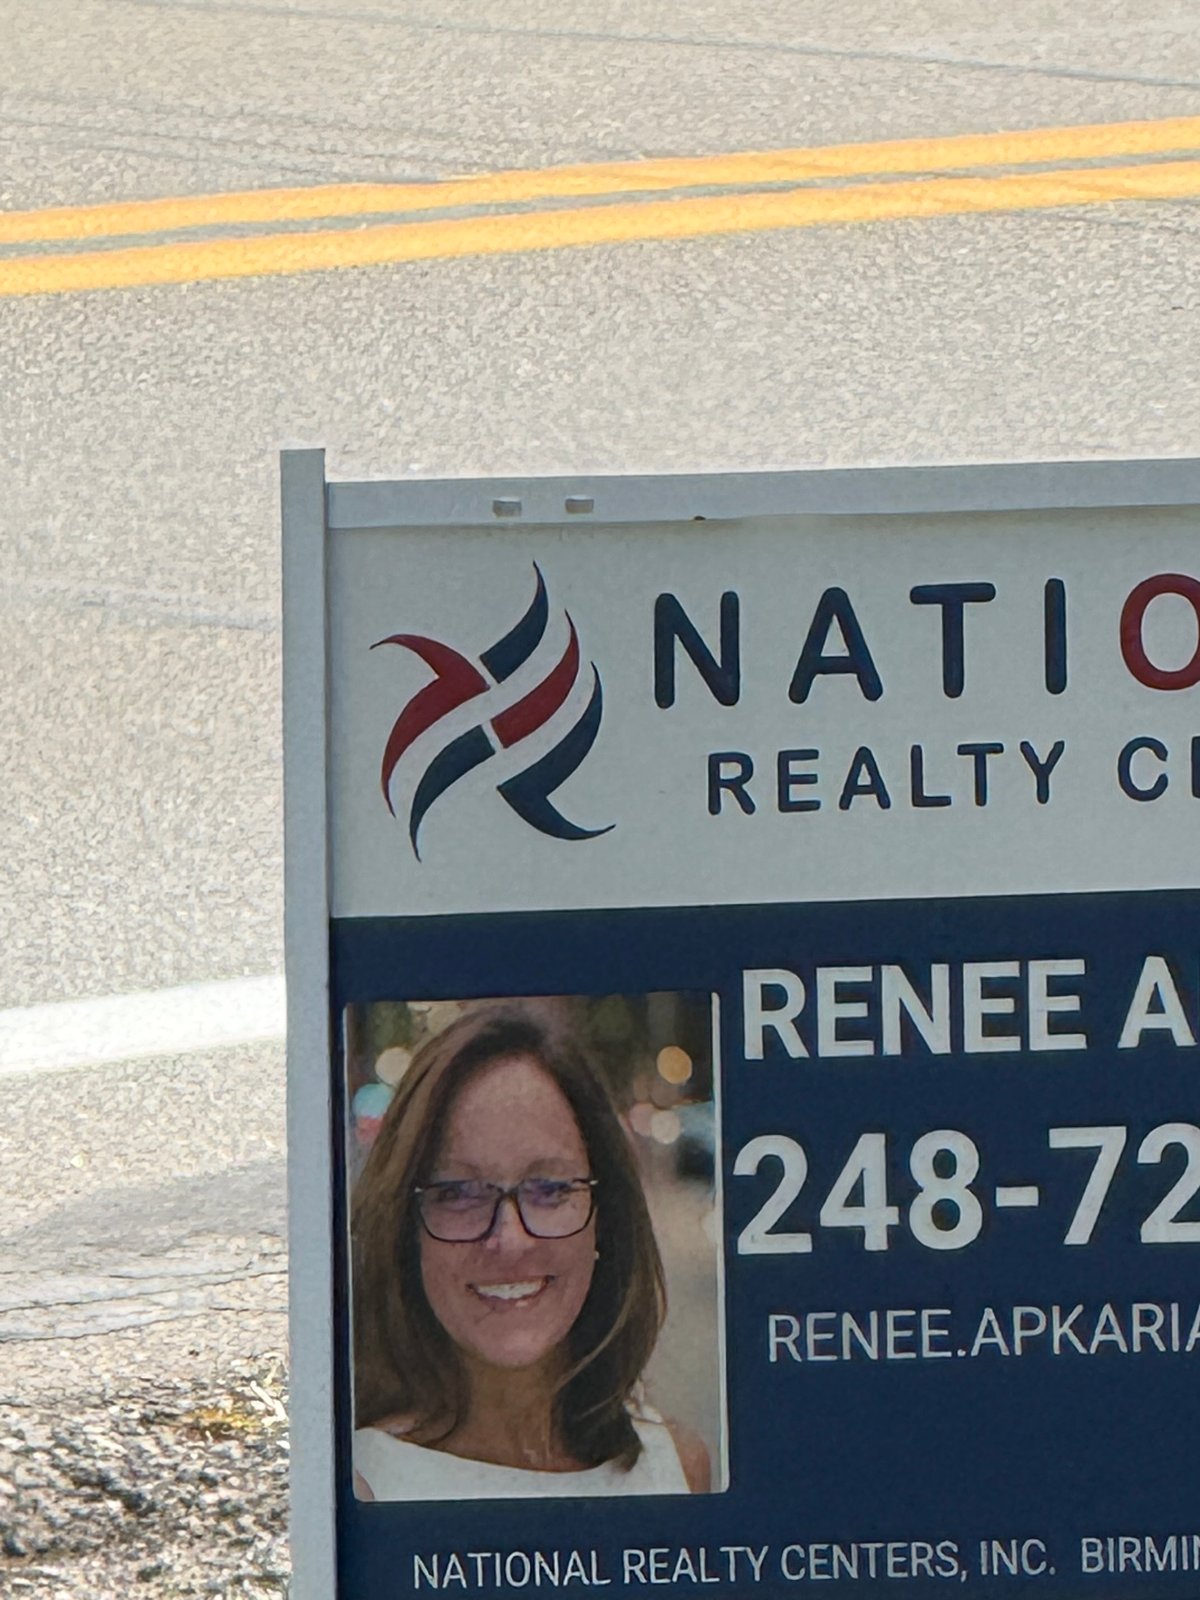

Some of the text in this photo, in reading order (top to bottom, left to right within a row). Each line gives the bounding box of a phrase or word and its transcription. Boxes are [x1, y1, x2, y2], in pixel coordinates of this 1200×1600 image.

[706, 739, 1065, 816] REALTY
[742, 958, 1088, 1060] RENEE
[412, 1549, 611, 1590] NATIONAL
[623, 1544, 770, 1586] REALTY
[781, 1539, 969, 1583] CENTERS,
[980, 1537, 1057, 1578] INC.
